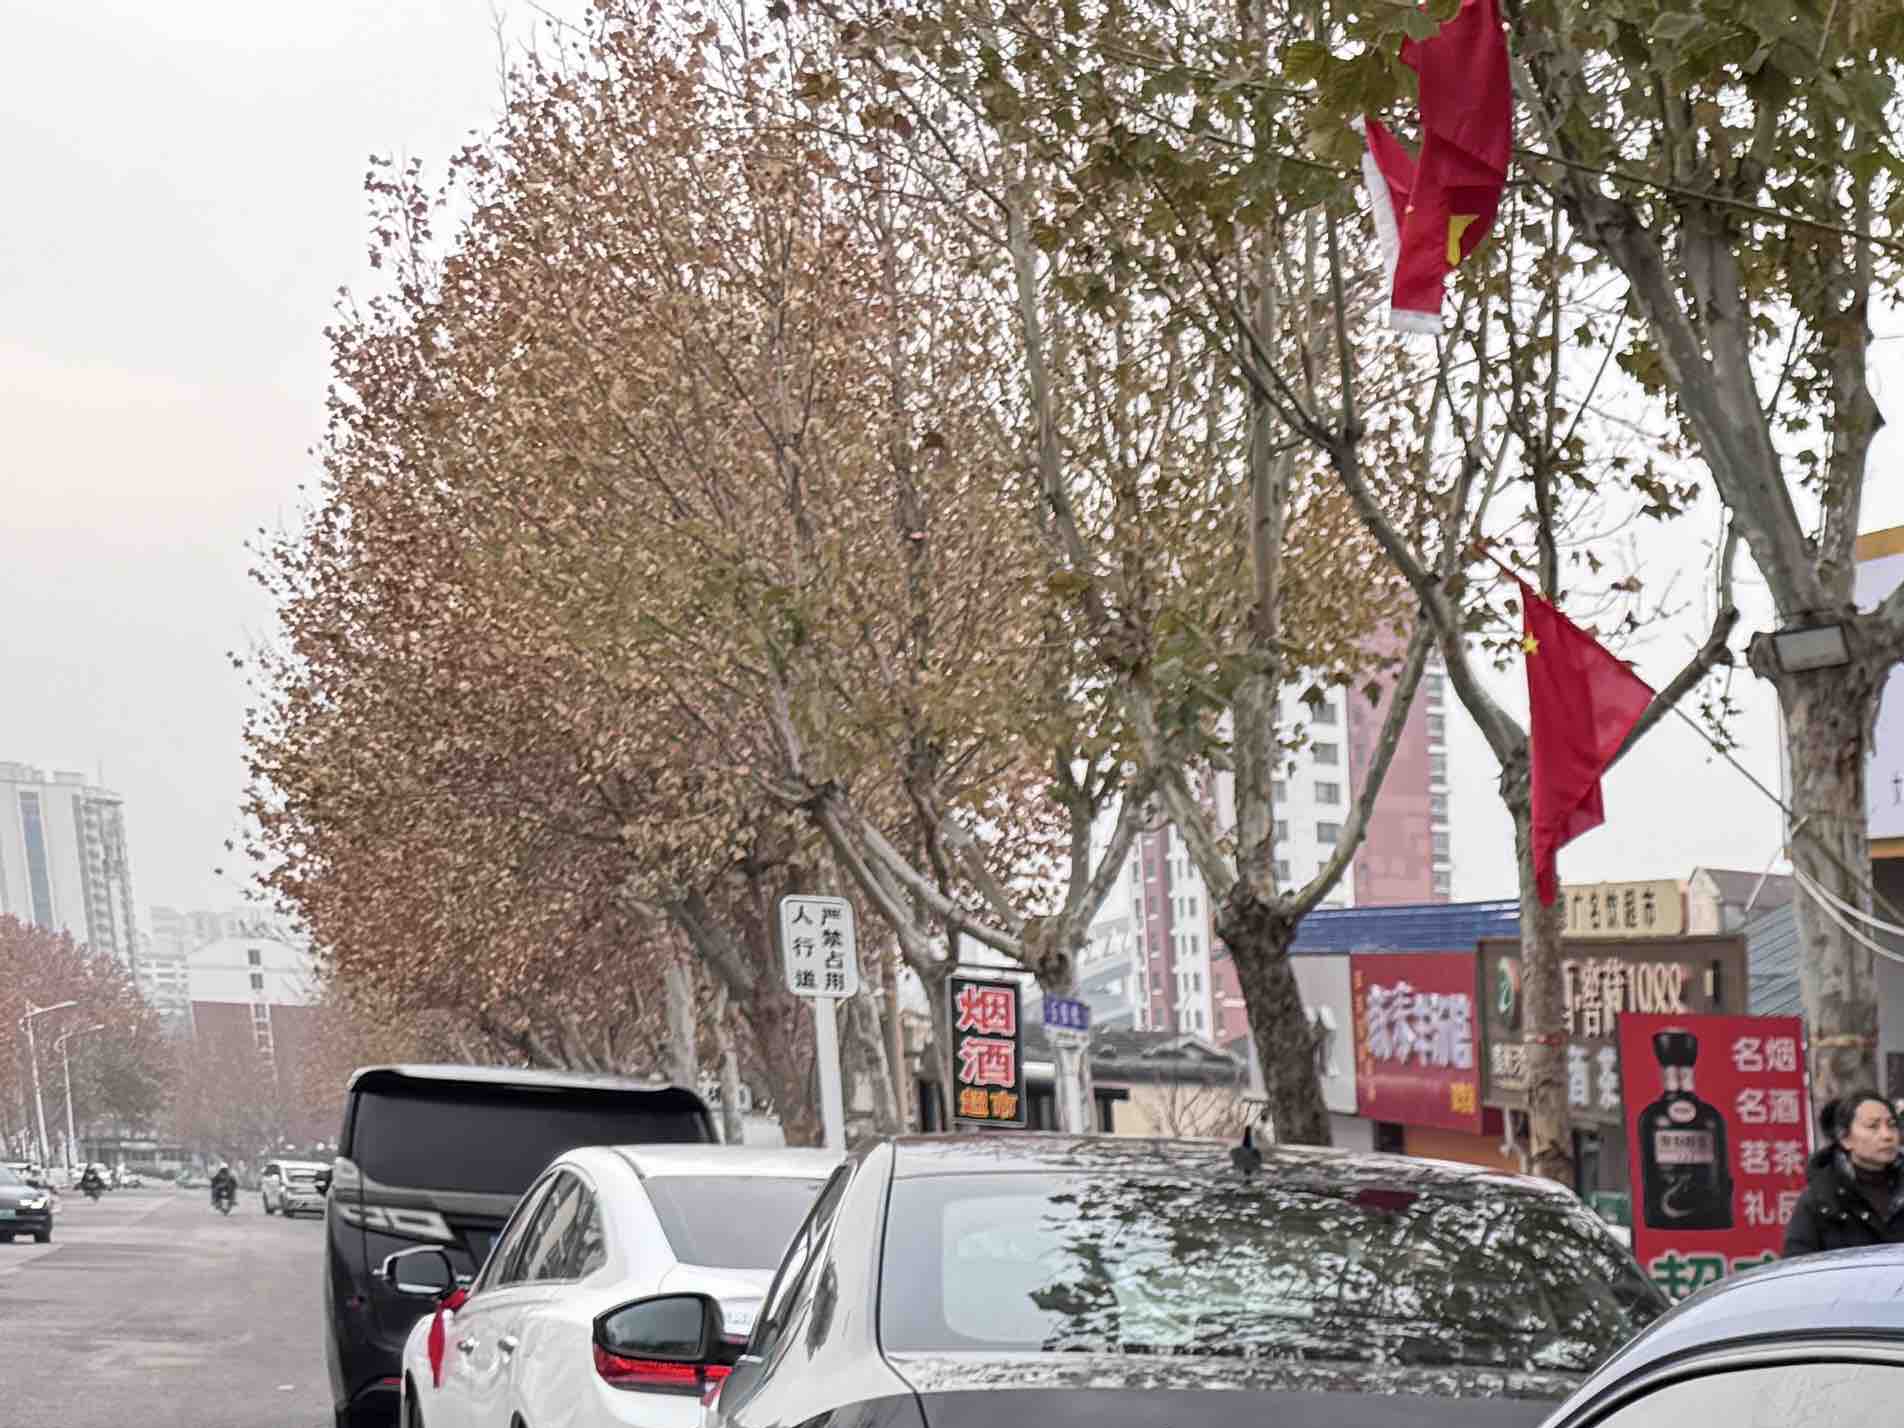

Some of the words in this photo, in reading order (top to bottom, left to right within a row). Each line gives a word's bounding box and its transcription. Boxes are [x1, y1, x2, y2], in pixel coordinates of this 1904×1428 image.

[791, 905, 816, 988] 人行道
[821, 907, 845, 990] 严禁占用
[956, 984, 1017, 1088] 烟酒
[1732, 1036, 1798, 1073] 名烟
[1737, 1088, 1801, 1125] 名酒
